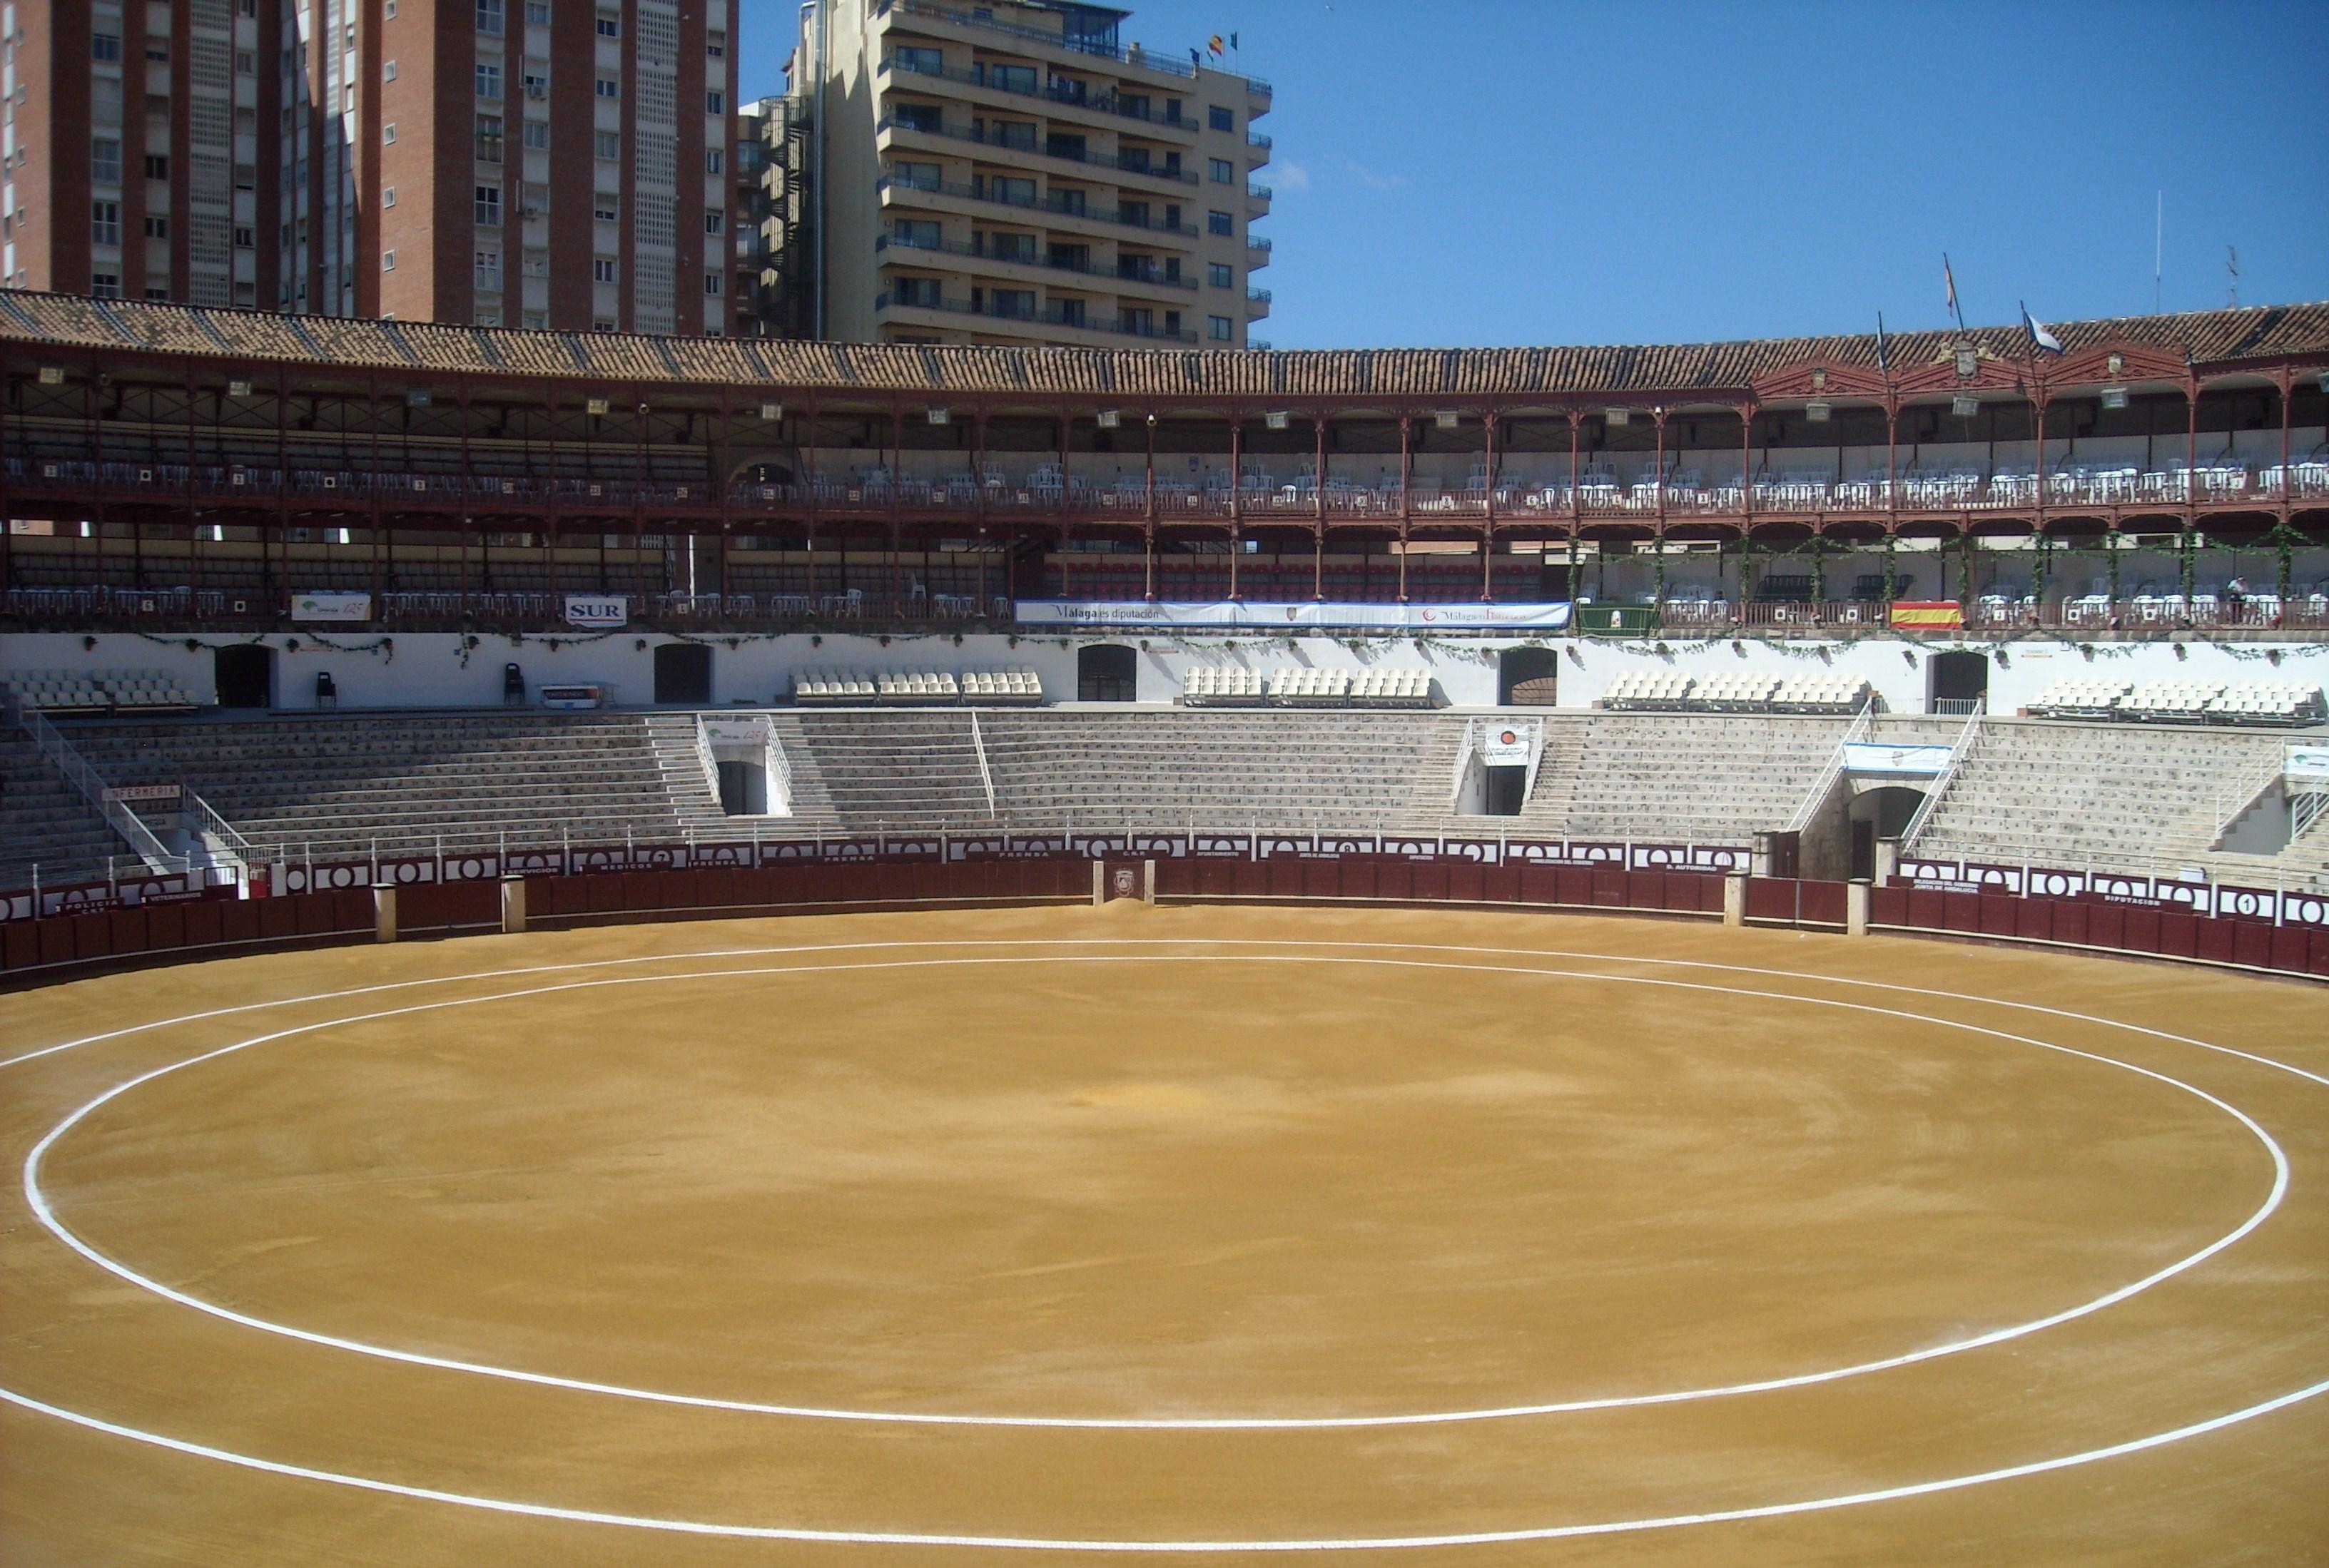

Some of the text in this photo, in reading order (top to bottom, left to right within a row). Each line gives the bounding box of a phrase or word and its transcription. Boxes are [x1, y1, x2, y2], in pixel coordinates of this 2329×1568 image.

[571, 604, 620, 616] SUR
[1112, 609, 1159, 619] diputación
[107, 787, 176, 798] NFERMERIA
[150, 892, 202, 902] VETERINARIOS
[2104, 895, 2161, 907] DIPUTACION
[66, 900, 118, 910] POLICIA
[2243, 898, 2250, 911] 1
